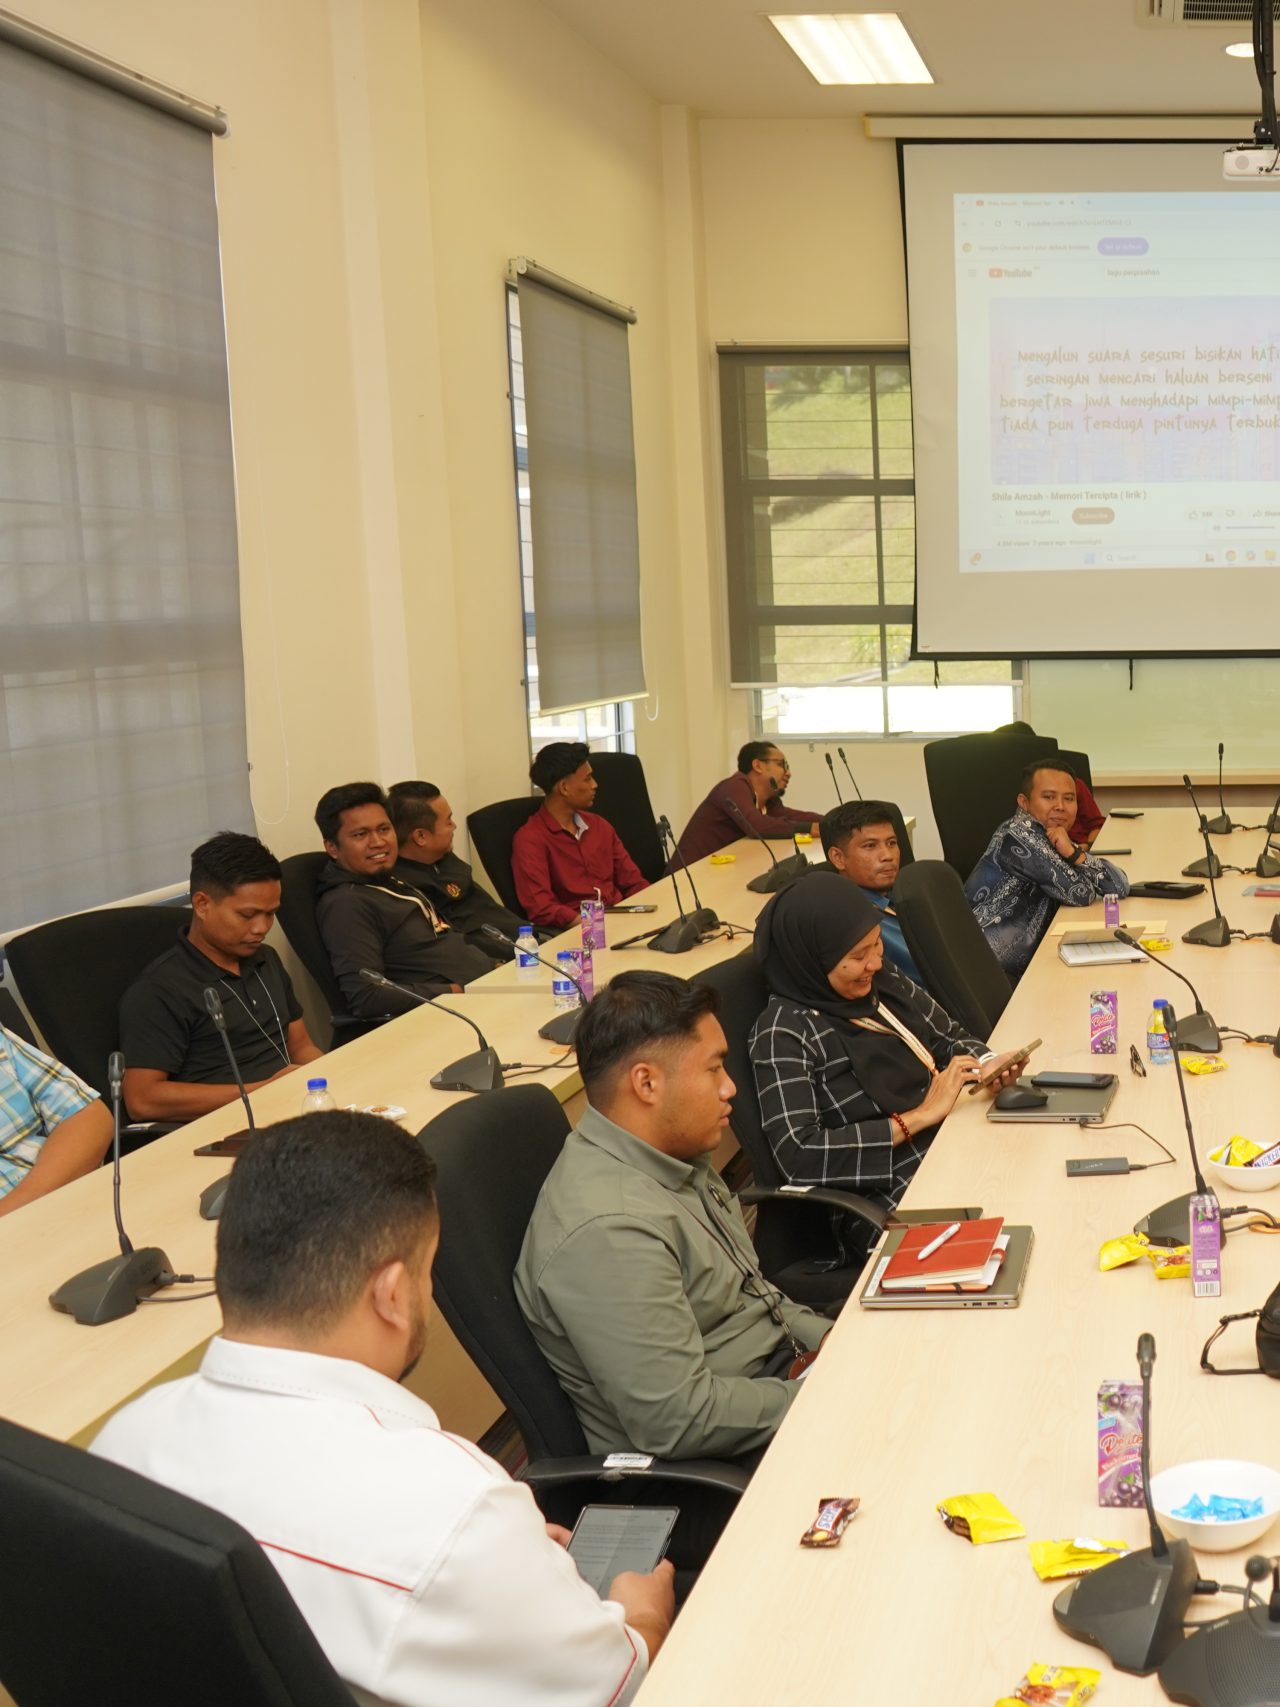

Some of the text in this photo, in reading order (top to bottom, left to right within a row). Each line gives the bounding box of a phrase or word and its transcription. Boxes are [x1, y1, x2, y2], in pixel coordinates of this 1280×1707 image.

[992, 492, 1012, 501] Shila
[1014, 492, 1043, 501] Amzah
[1051, 492, 1082, 500] Memori
[1085, 491, 1118, 502] Tercipta
[1125, 491, 1141, 500] lirik
